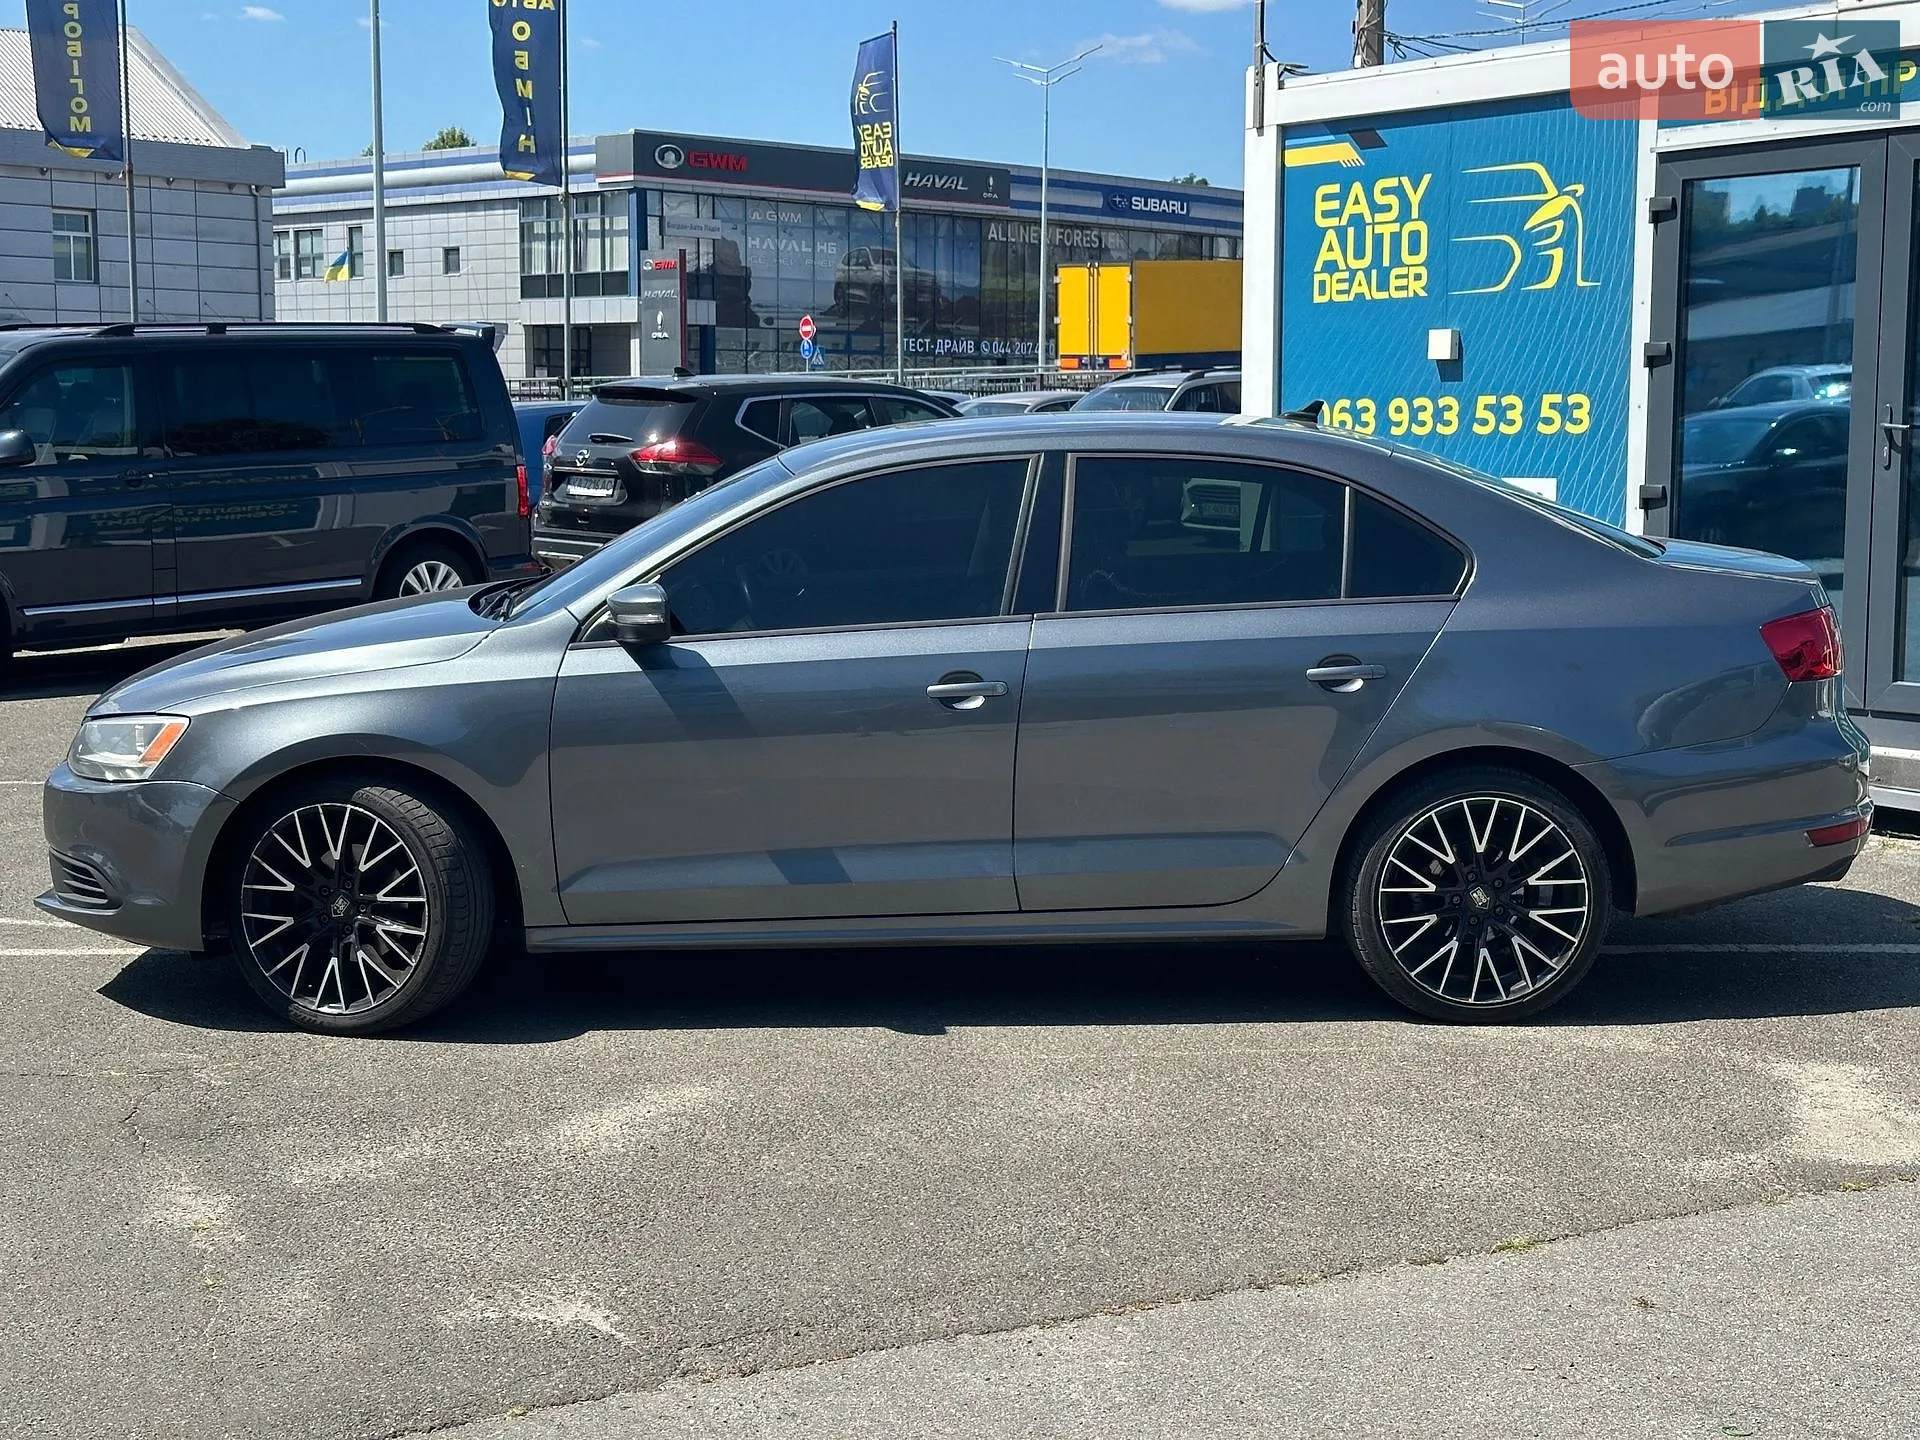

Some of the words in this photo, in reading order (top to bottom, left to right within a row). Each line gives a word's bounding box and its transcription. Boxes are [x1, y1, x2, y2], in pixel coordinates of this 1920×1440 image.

[688, 151, 748, 171] GWM
[904, 171, 969, 191] HAVAL
[1131, 196, 1188, 215] SUBARU
[1314, 173, 1432, 228] EASY
[766, 210, 802, 224] GWM
[748, 237, 812, 252] HAVAL
[987, 223, 1016, 242] ALL
[1056, 228, 1125, 250] FORESTER
[1313, 220, 1428, 272] AUTO
[643, 289, 678, 299] HAVAL
[1313, 266, 1428, 303] DEALER
[903, 337, 975, 355] ТЕСТ-ДРАЙВ
[1388, 397, 1460, 436] 933
[1472, 395, 1524, 435] 53
[1536, 393, 1591, 435] 53
